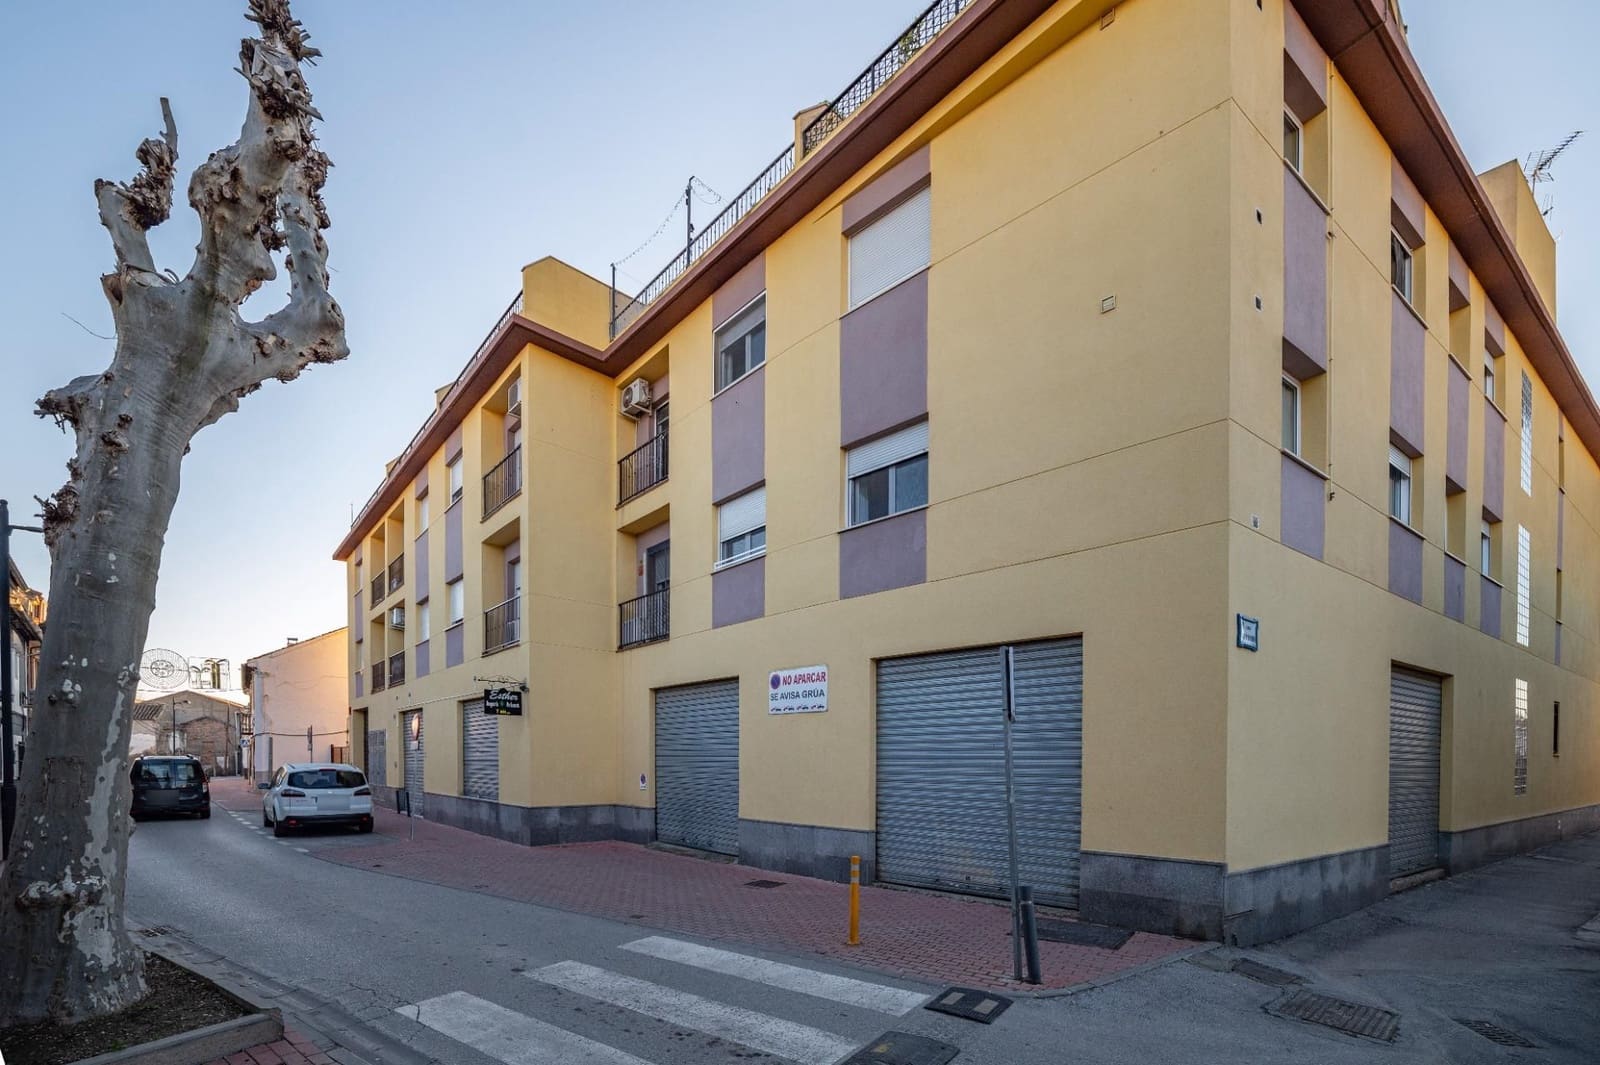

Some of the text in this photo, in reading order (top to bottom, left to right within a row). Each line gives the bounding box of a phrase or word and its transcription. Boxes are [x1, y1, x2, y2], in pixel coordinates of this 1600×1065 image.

[782, 671, 826, 686] NO APARCAR
[770, 687, 825, 702] SE AVISA GRÚA
